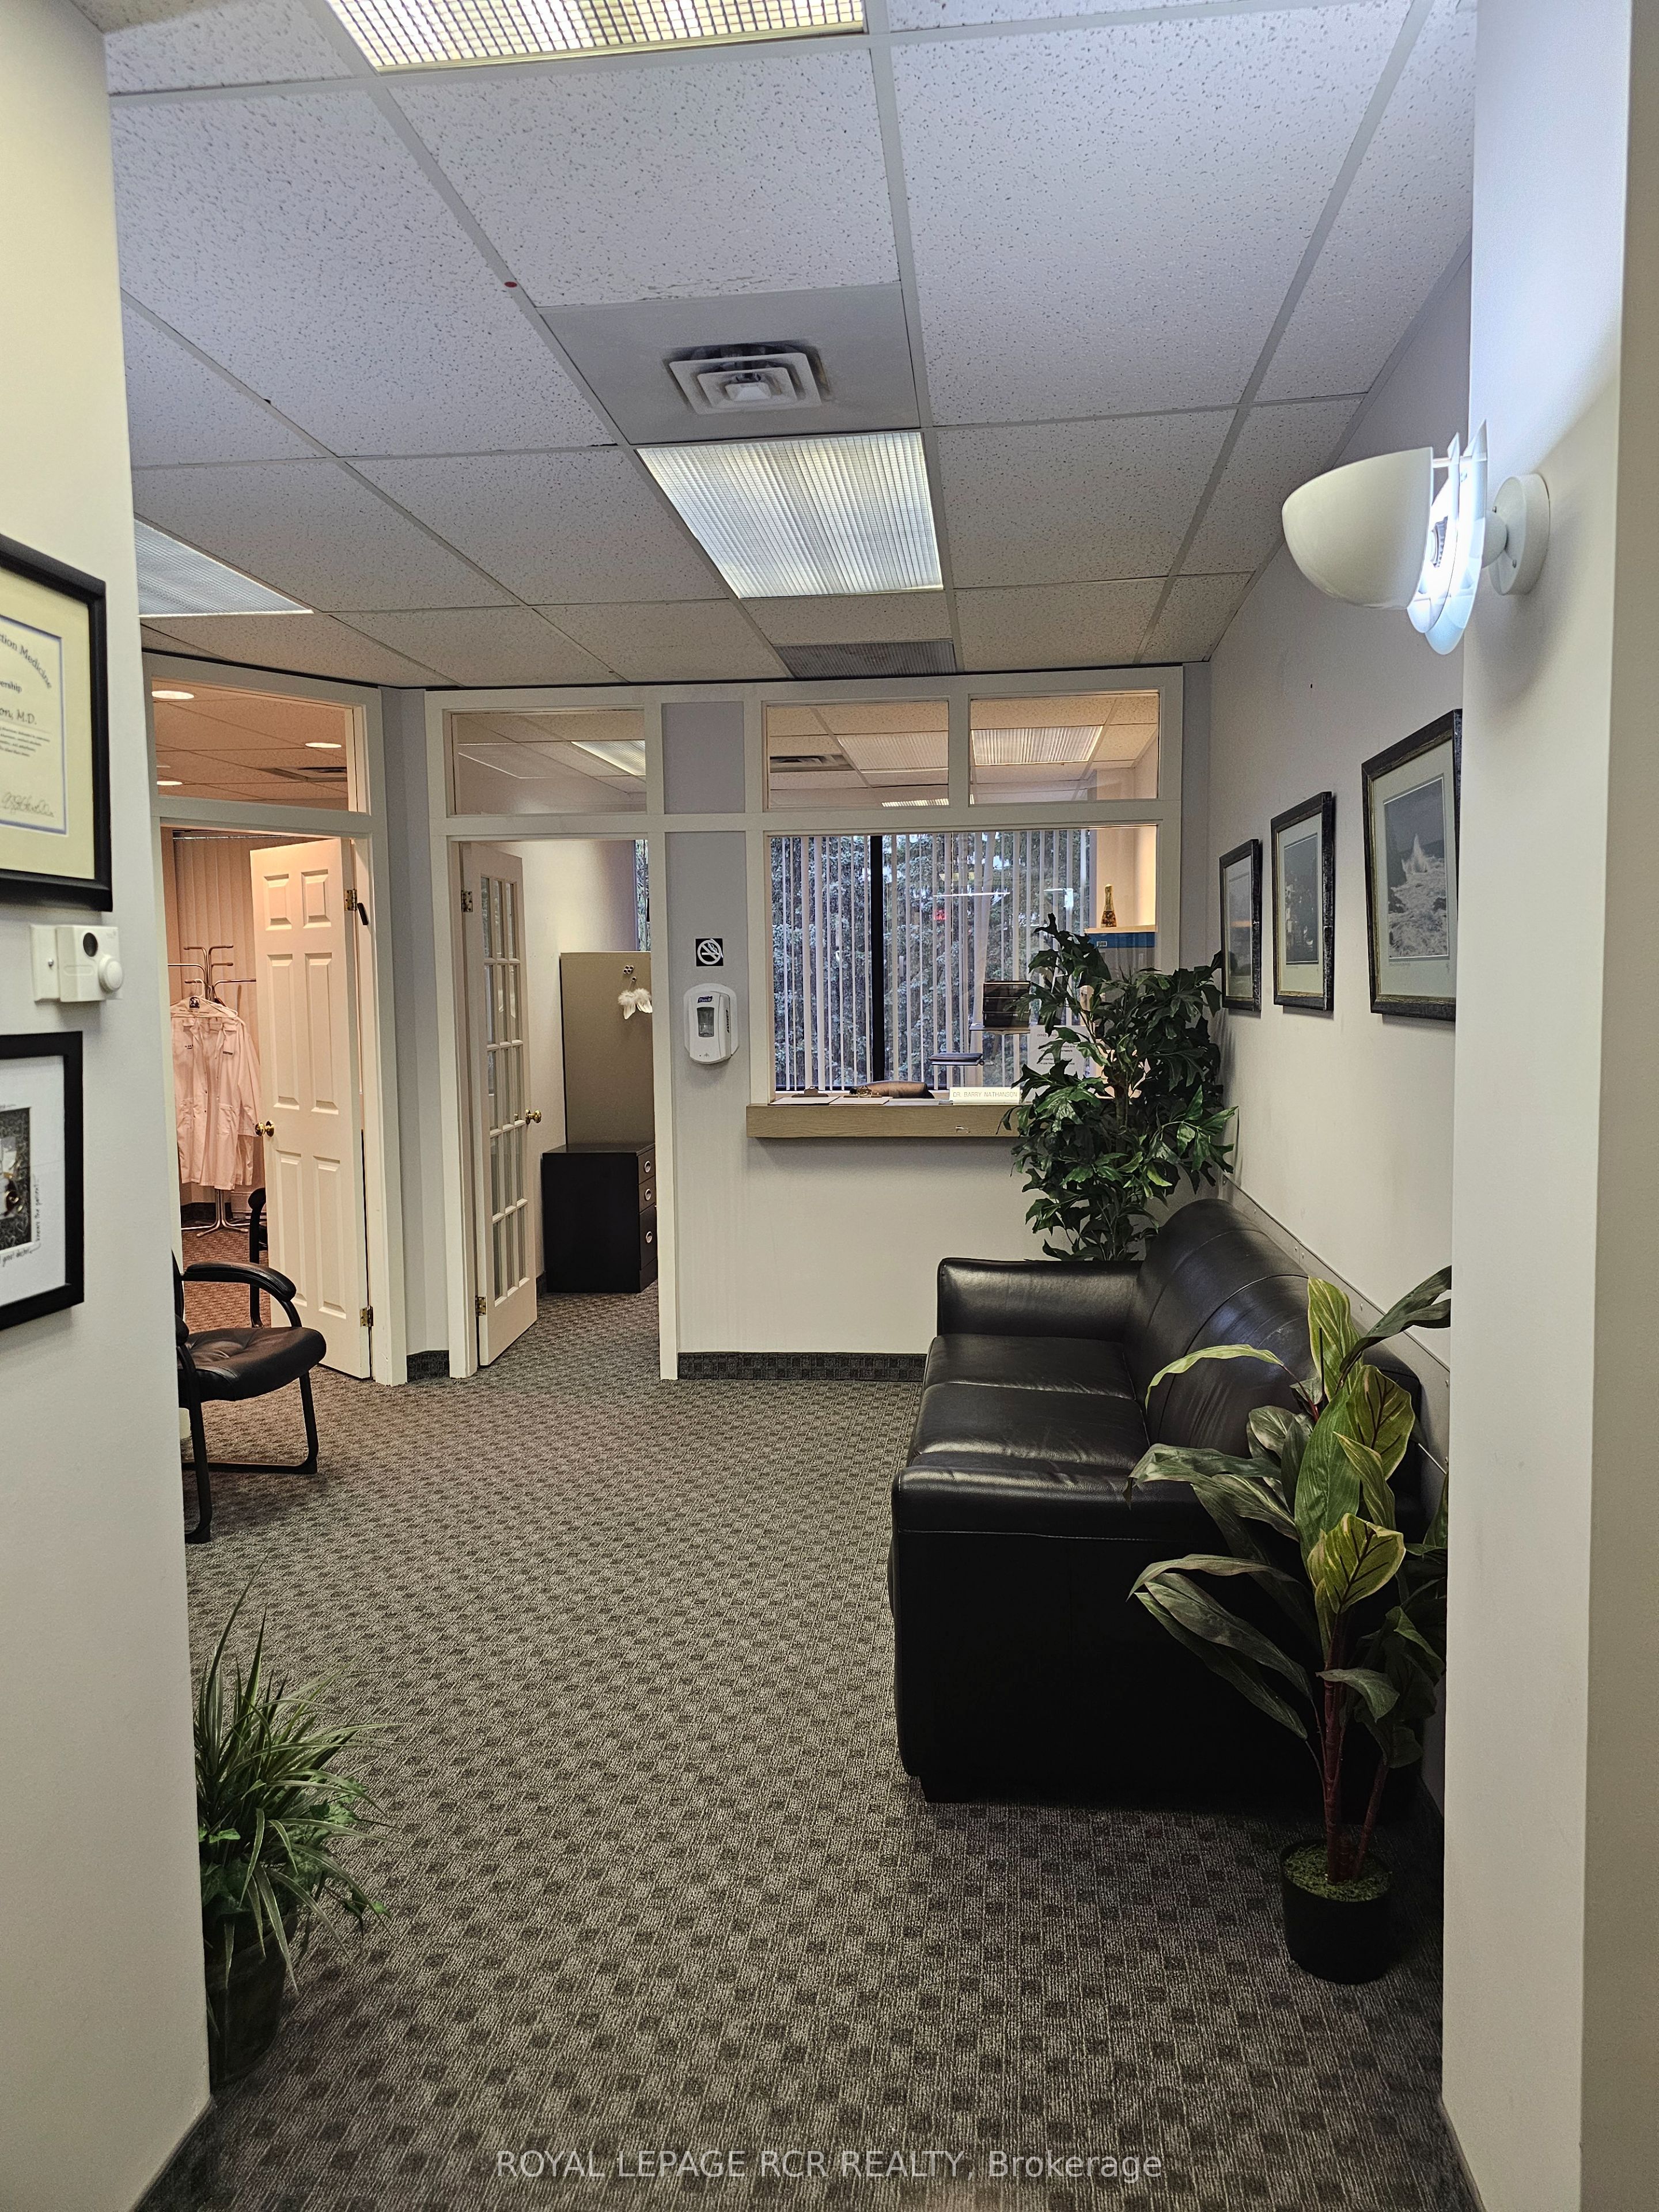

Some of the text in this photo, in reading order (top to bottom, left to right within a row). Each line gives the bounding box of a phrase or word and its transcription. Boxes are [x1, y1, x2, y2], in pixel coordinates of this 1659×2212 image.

[0, 633, 52, 690] tion Medicine
[0, 680, 22, 694] ership
[17, 709, 37, 725] M.D.
